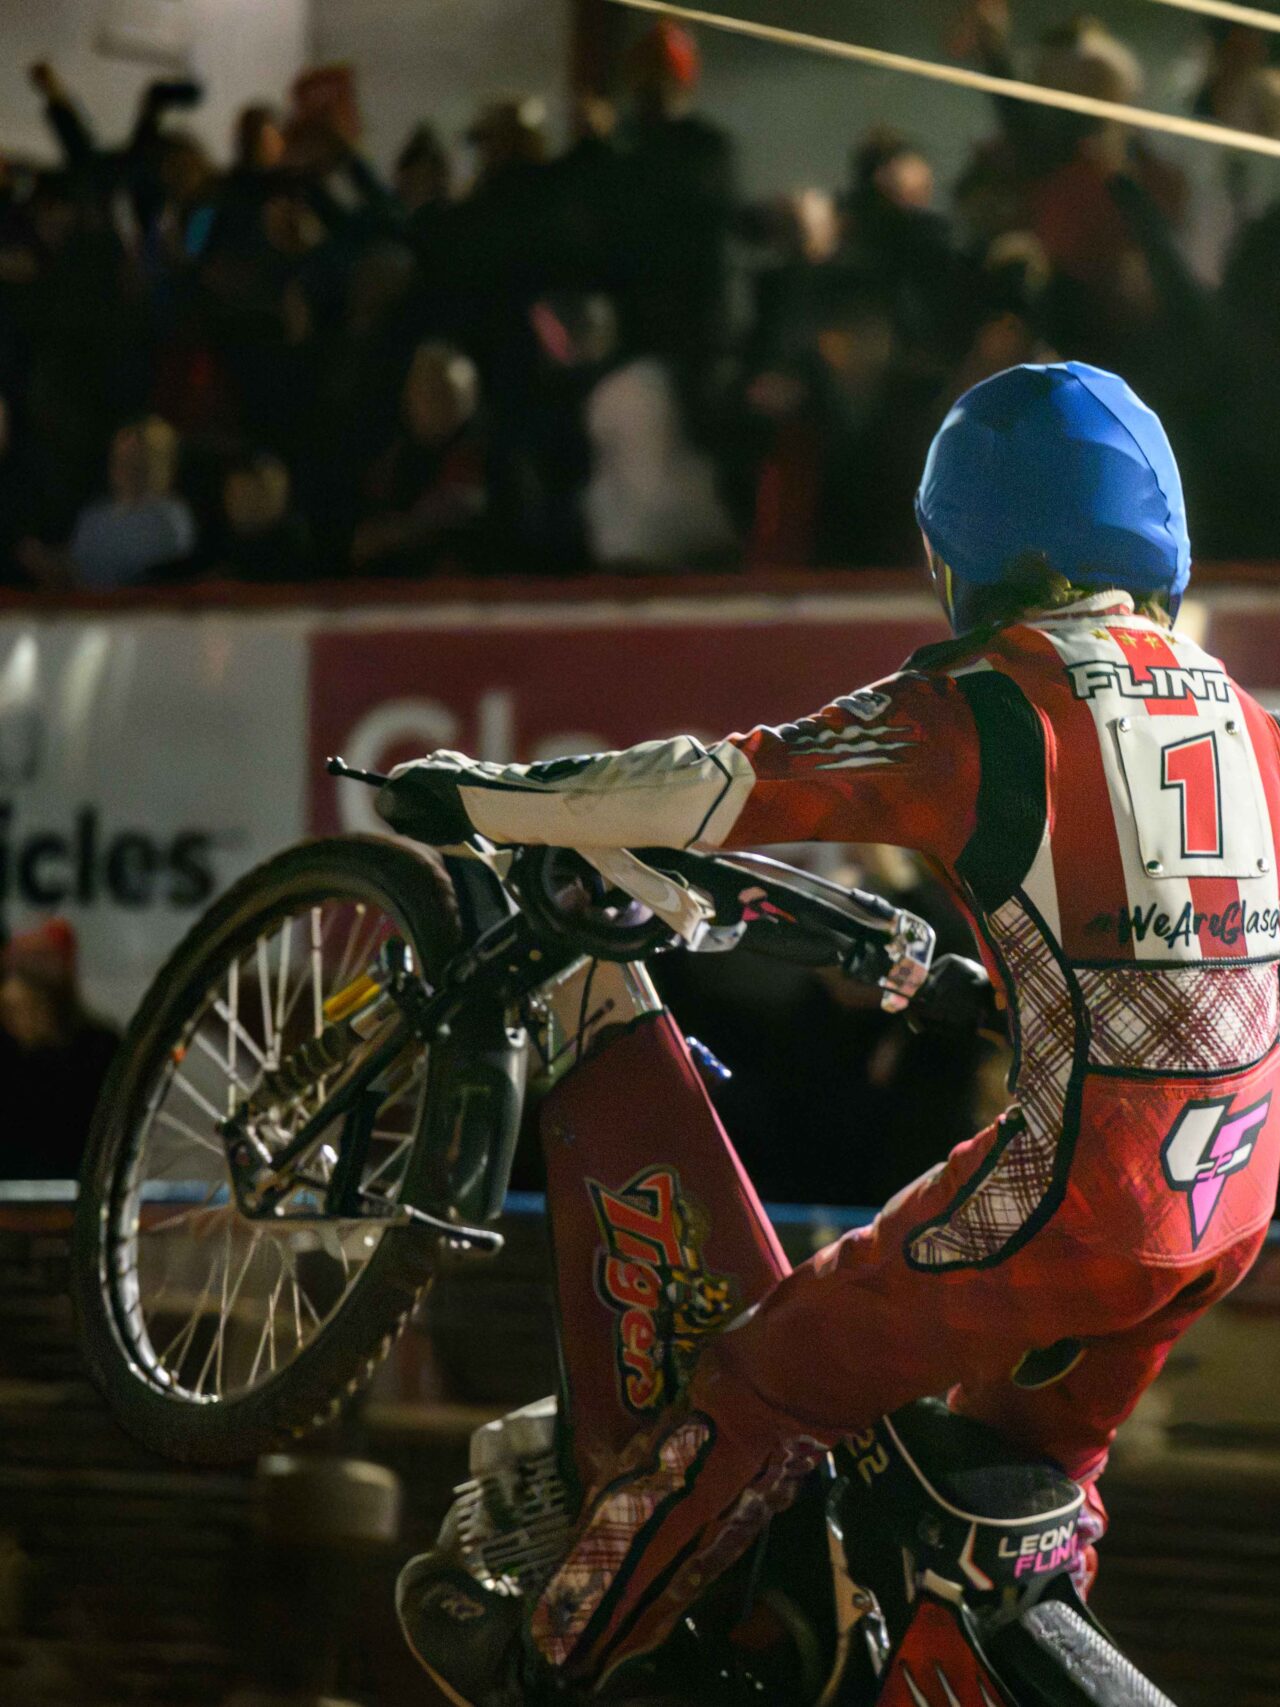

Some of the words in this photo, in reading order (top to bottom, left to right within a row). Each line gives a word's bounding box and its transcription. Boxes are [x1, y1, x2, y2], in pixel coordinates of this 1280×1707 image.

[1064, 661, 1232, 702] FLINT
[1160, 731, 1224, 859] 1
[998, 1519, 1076, 1558] LEON
